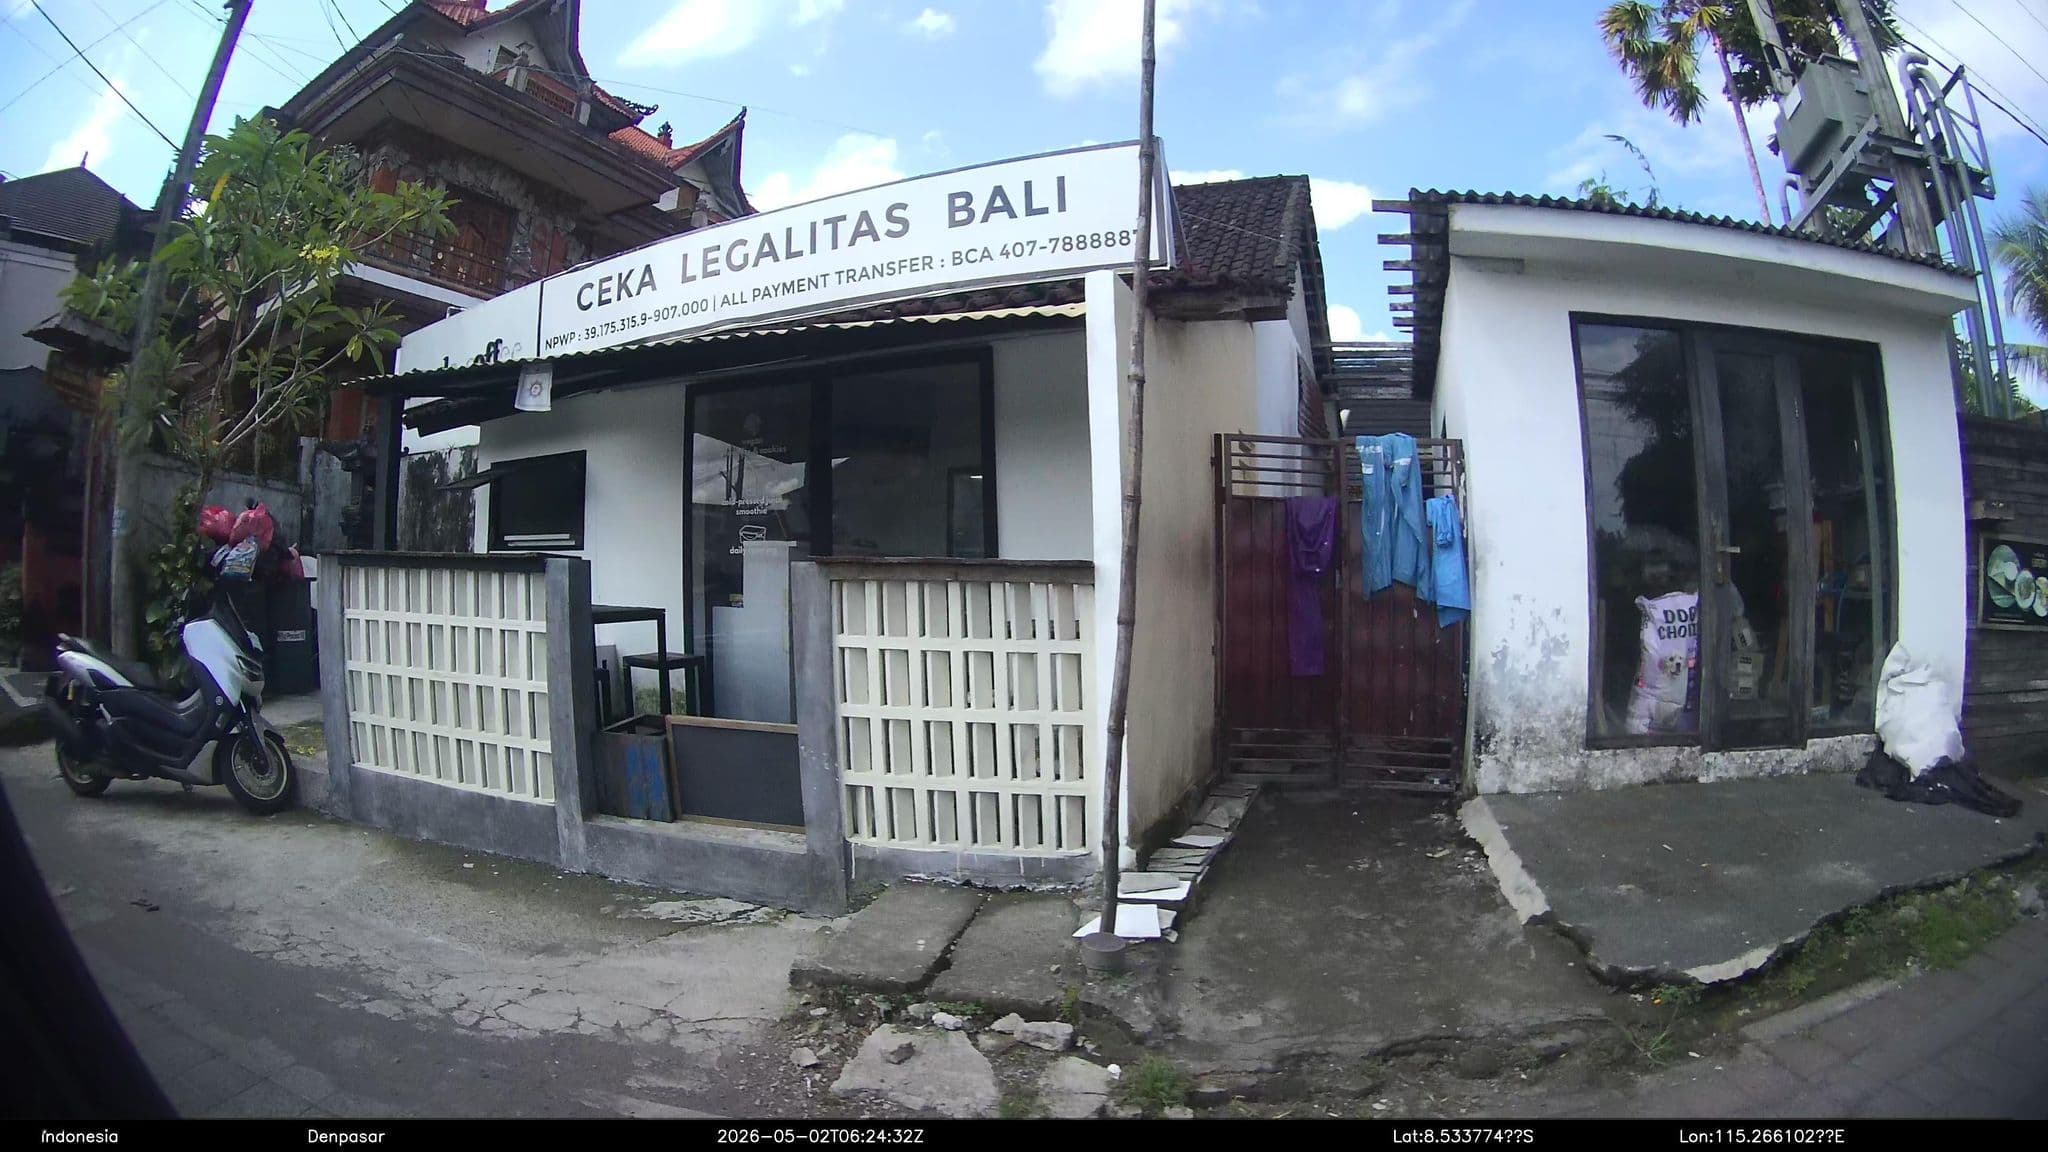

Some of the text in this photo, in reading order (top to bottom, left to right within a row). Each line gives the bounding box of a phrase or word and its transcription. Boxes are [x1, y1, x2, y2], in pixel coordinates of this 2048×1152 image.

[545, 332, 576, 351] NPWP
[584, 298, 709, 340] 39.175.315.9-907.000
[720, 291, 747, 308] ALL
[752, 273, 830, 303] PAYMENT
[835, 255, 934, 285] TRANSFER
[952, 247, 994, 266] BCA
[999, 229, 1139, 260] 407-788888
[576, 175, 1067, 311] CEKA LEGALITAS BALI
